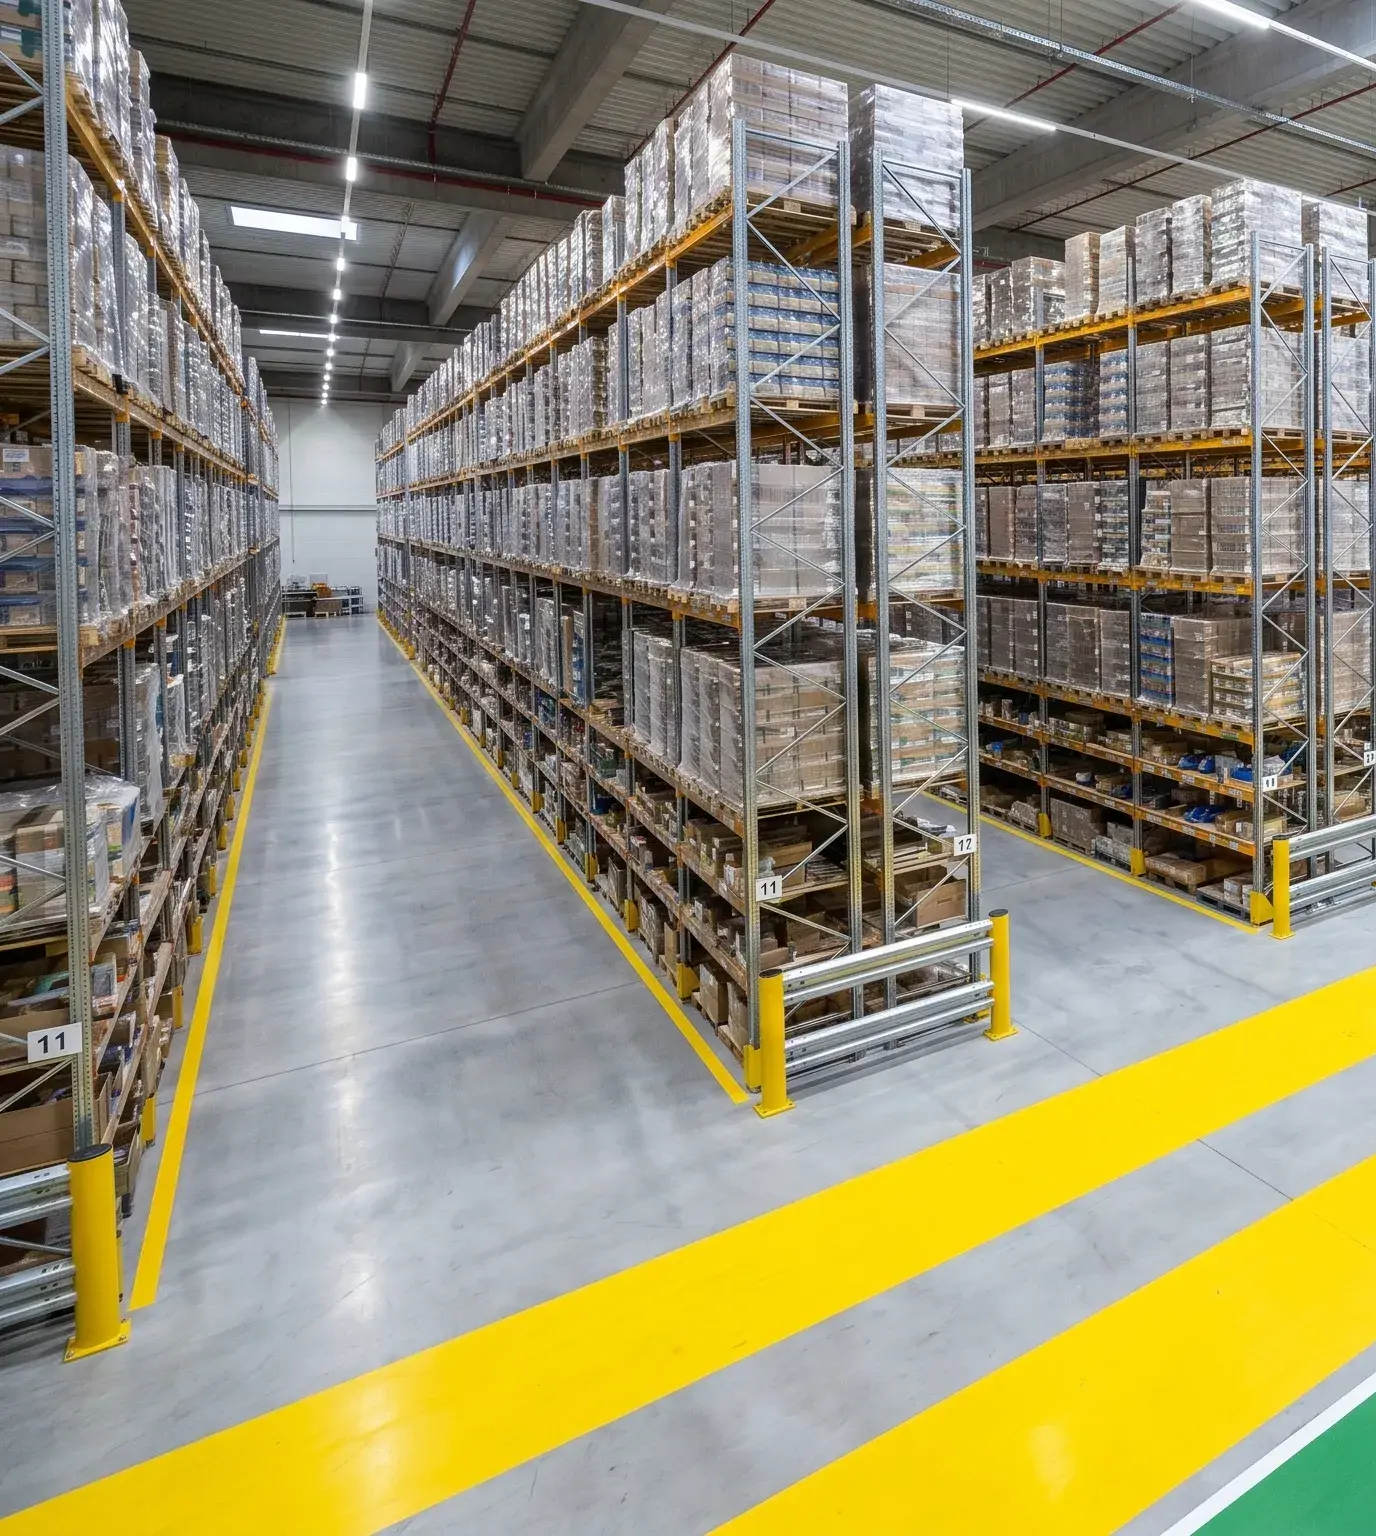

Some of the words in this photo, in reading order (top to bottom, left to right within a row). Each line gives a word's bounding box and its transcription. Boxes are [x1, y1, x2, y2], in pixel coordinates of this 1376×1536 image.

[958, 838, 972, 851] 12
[760, 880, 776, 895] 11
[37, 1031, 65, 1054] 11
